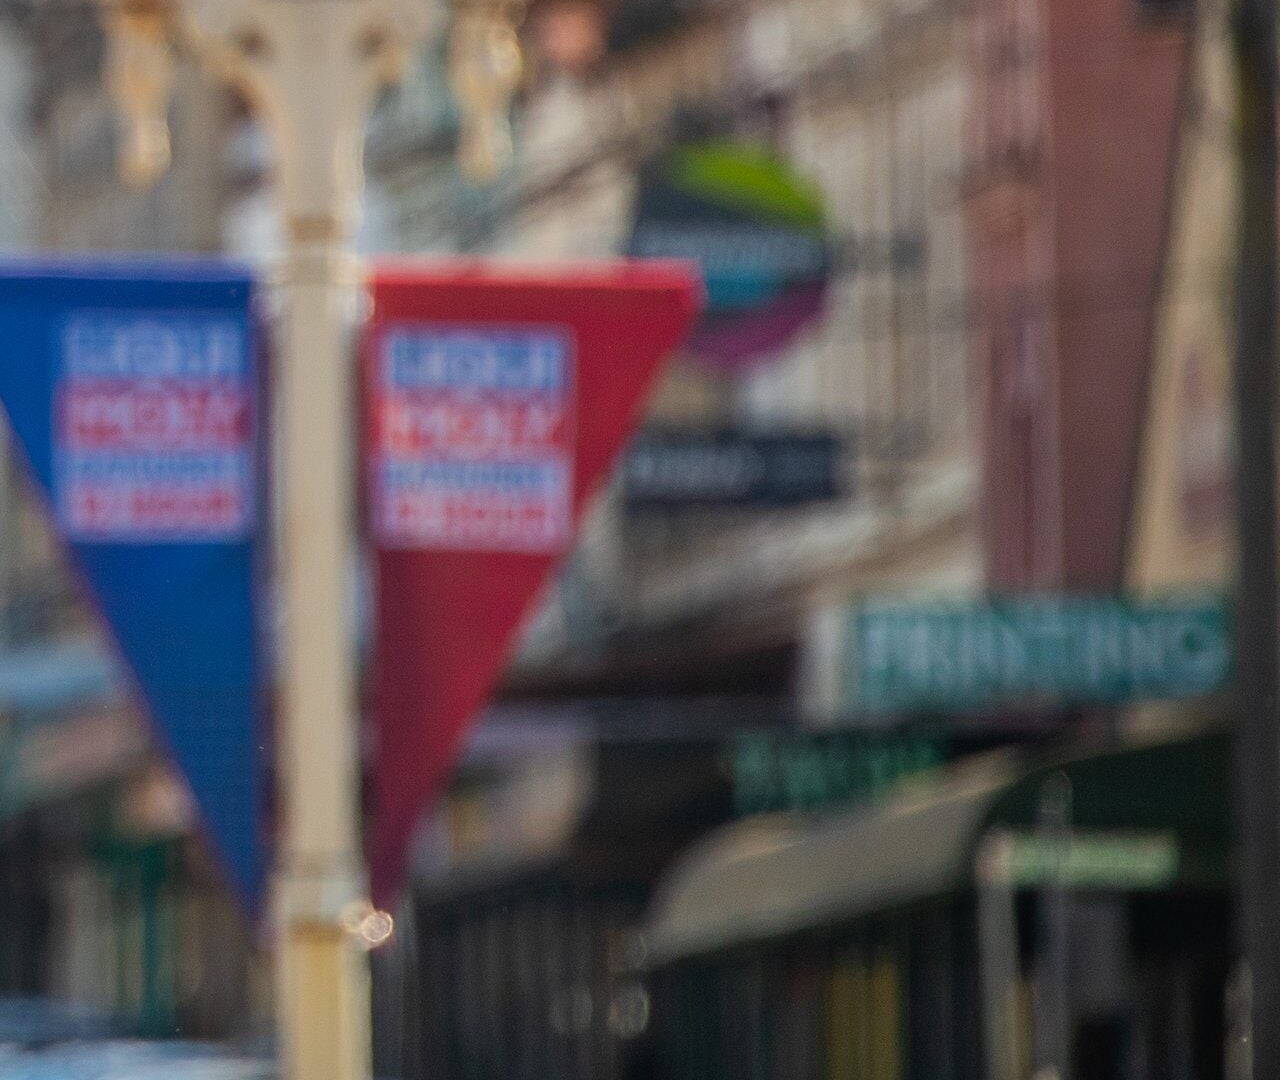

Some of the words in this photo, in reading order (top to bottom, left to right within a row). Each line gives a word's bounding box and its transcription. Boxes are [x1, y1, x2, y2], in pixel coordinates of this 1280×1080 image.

[62, 319, 243, 376] LIQUI
[384, 334, 562, 390] LIQUI
[61, 392, 246, 447] MOLY
[383, 403, 566, 458] MOLY
[857, 605, 1231, 701] PRINTING
